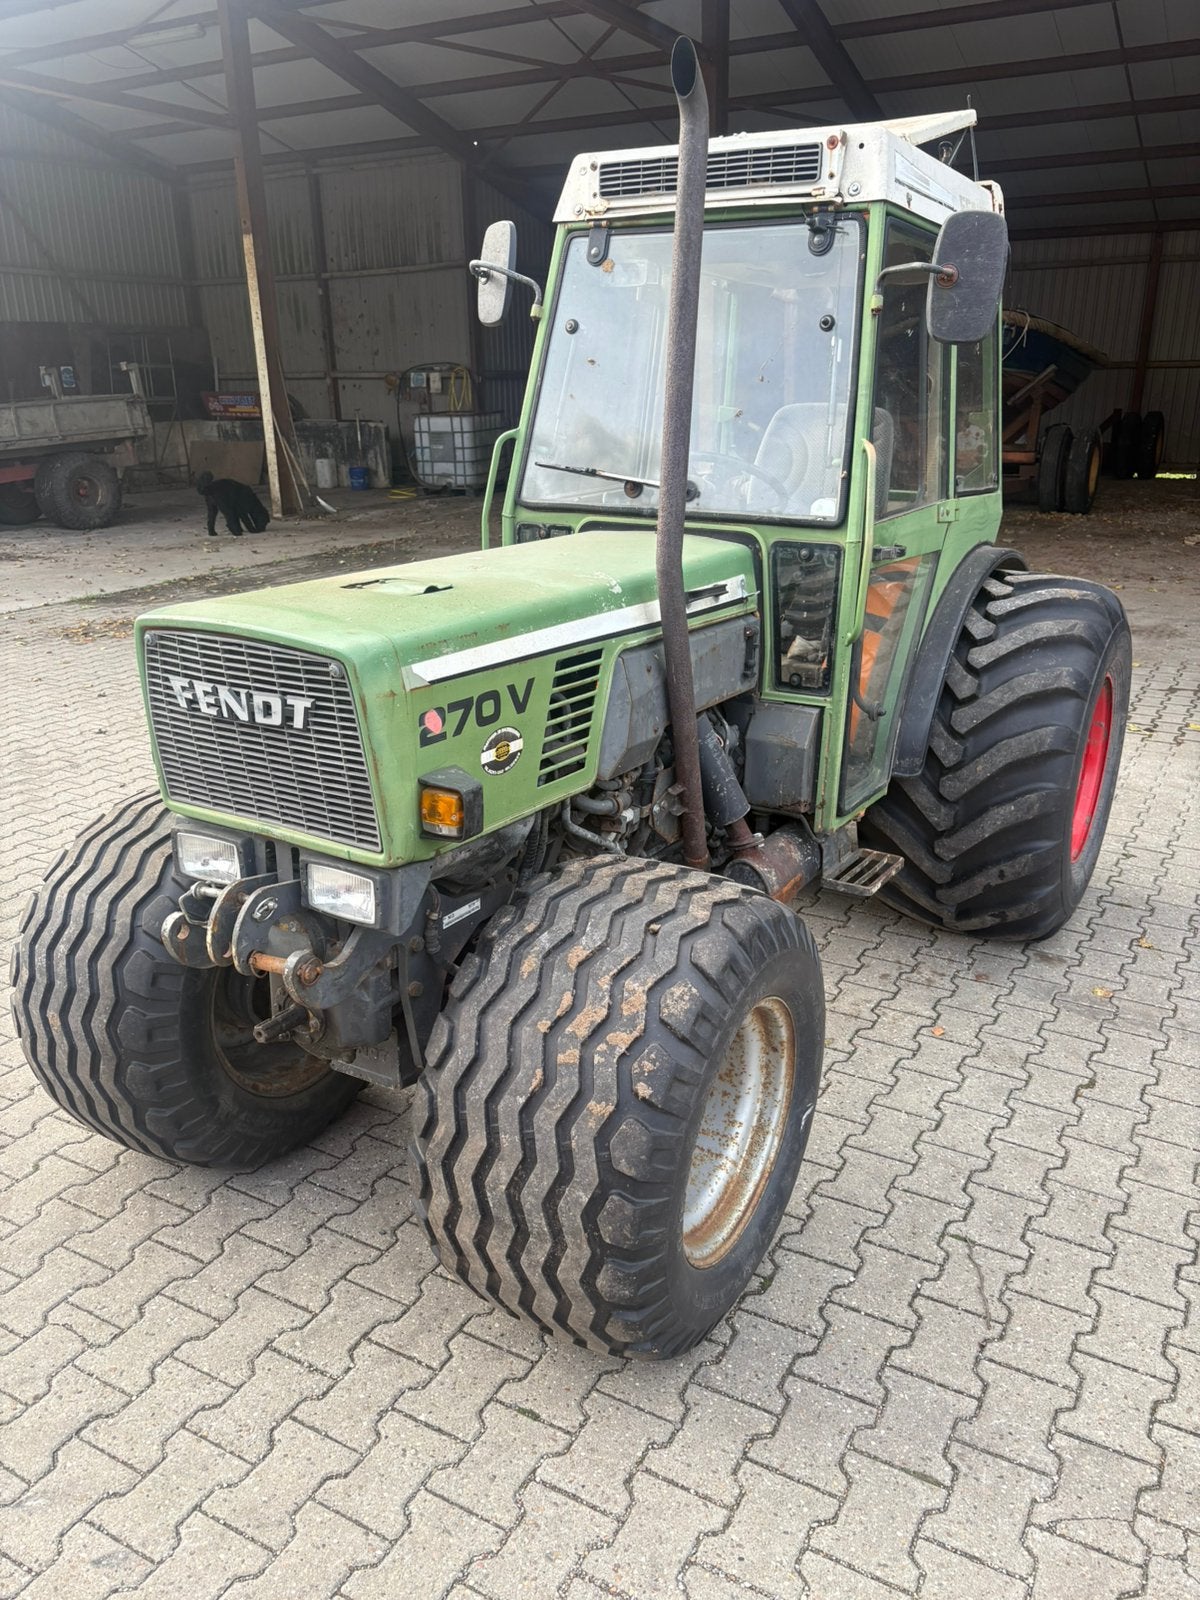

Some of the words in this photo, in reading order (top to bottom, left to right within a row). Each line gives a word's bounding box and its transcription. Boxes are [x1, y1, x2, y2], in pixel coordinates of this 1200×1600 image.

[168, 675, 315, 729] FENDT
[418, 689, 501, 748] 270
[506, 677, 535, 714] V
